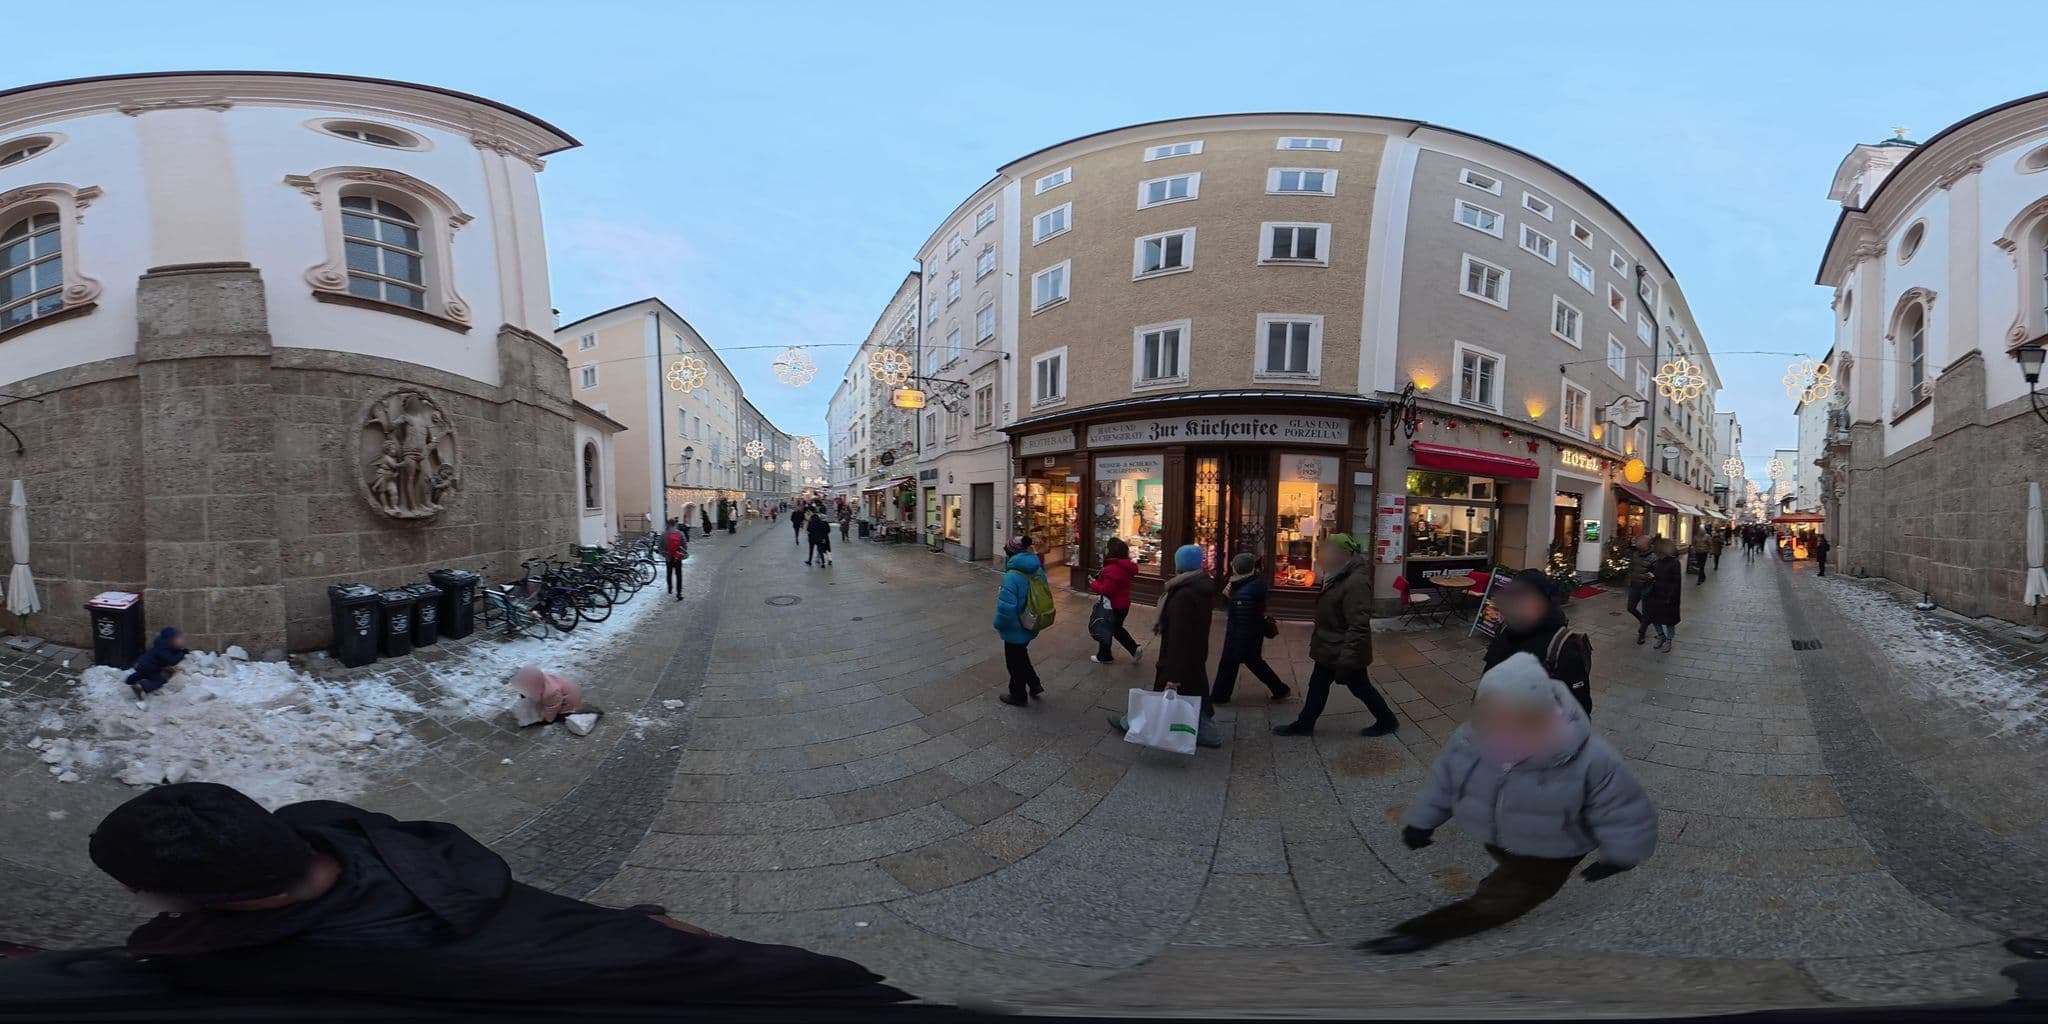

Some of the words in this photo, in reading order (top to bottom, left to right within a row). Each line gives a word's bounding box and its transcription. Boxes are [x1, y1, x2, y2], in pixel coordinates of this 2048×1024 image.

[1149, 422, 1178, 440] Zur
[1185, 419, 1278, 440] Küchenfee
[1289, 419, 1316, 429] GLAS
[1318, 419, 1339, 430] UND
[1284, 428, 1341, 440] PORZELLAN
[1562, 449, 1599, 471] HOTEL
